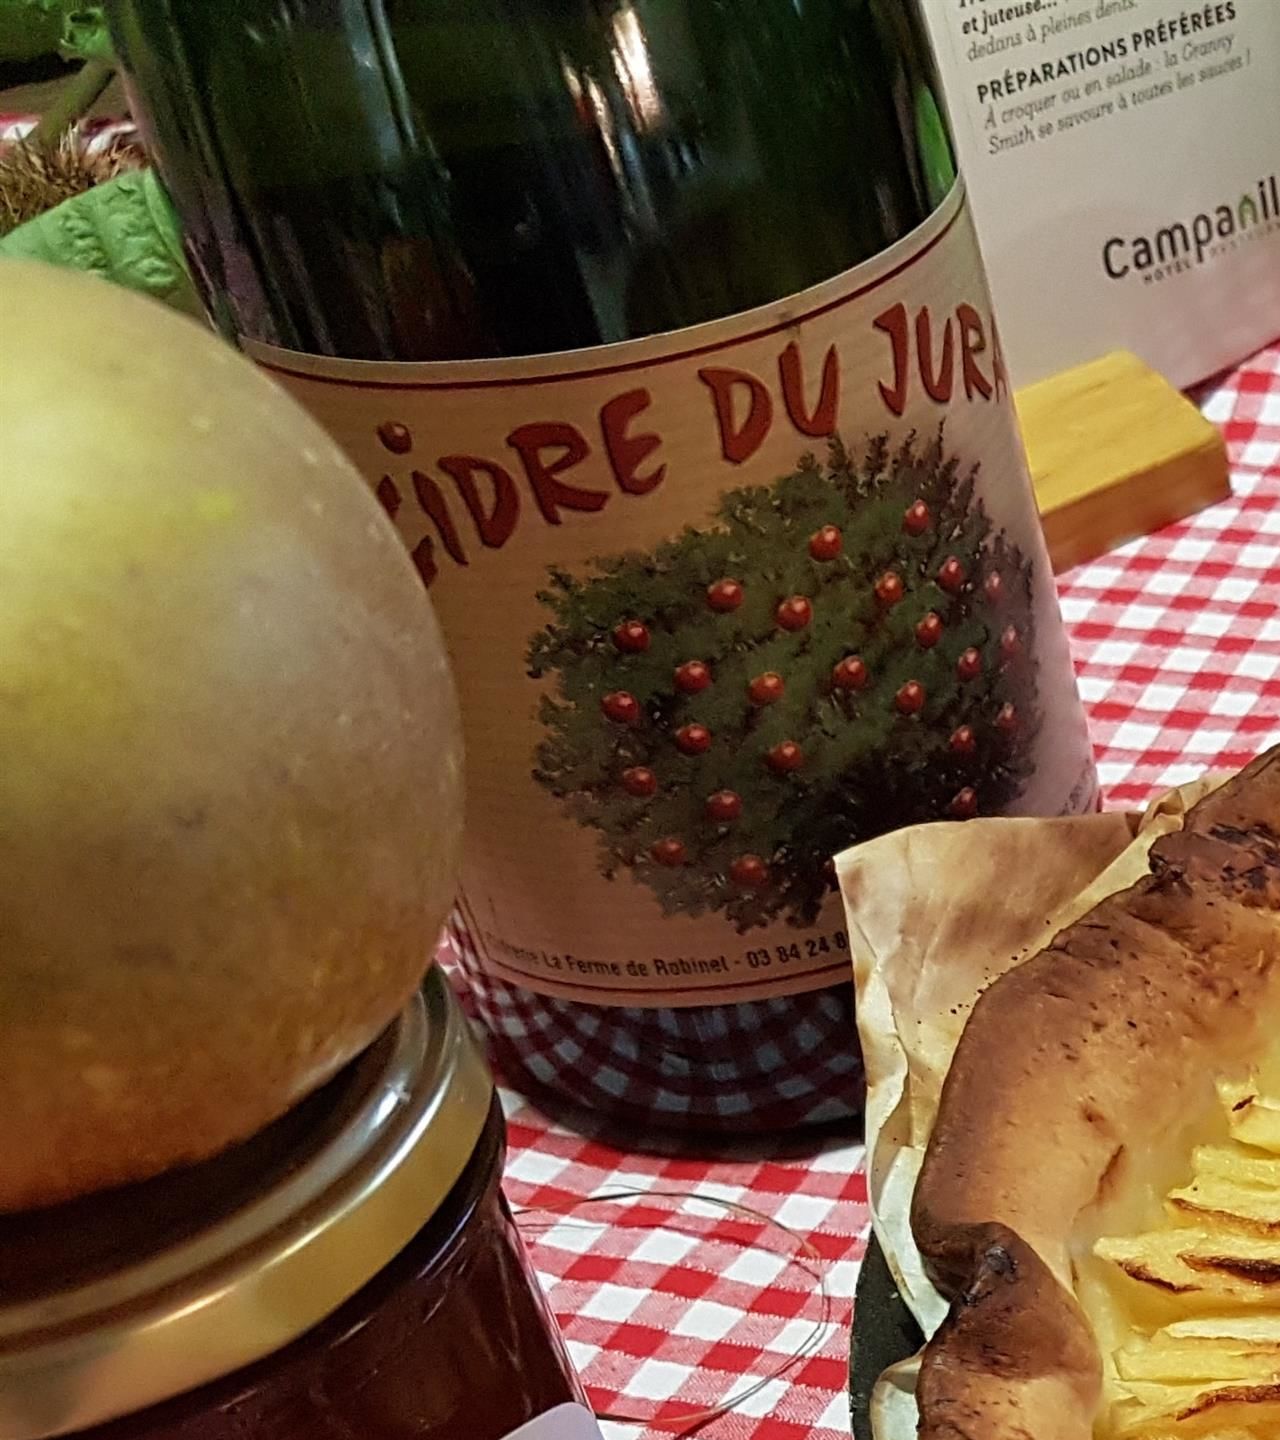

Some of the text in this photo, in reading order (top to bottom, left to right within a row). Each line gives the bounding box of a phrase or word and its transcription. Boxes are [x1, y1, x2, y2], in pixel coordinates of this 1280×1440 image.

[962, 17, 978, 35] et
[967, 32, 1022, 62] dedans
[1026, 23, 1037, 42] à
[1040, 10, 1093, 43] pleines
[976, 1, 1236, 104] PRÉPARATIONS PRÉFÉRÉES
[989, 124, 1035, 155] Smith
[1038, 122, 1053, 139] se
[1057, 101, 1113, 131] savoure
[1132, 81, 1173, 105] toutes
[1176, 71, 1195, 91] les
[1198, 55, 1242, 83] sauces
[1002, 94, 1056, 123] croquer
[1062, 87, 1080, 102] ou
[1084, 79, 1102, 97] en
[1106, 58, 1151, 88] salade
[1164, 50, 1178, 69] la
[1182, 34, 1234, 62] Granny
[698, 341, 840, 464] DU
[873, 302, 1008, 416] JURA
[542, 950, 563, 971] La
[564, 953, 621, 977] Ferme
[626, 959, 649, 977] de
[653, 955, 730, 977] Robinet
[747, 947, 771, 969] 03
[776, 943, 801, 964] 84
[805, 936, 831, 957] 24
[834, 931, 849, 949] 8
